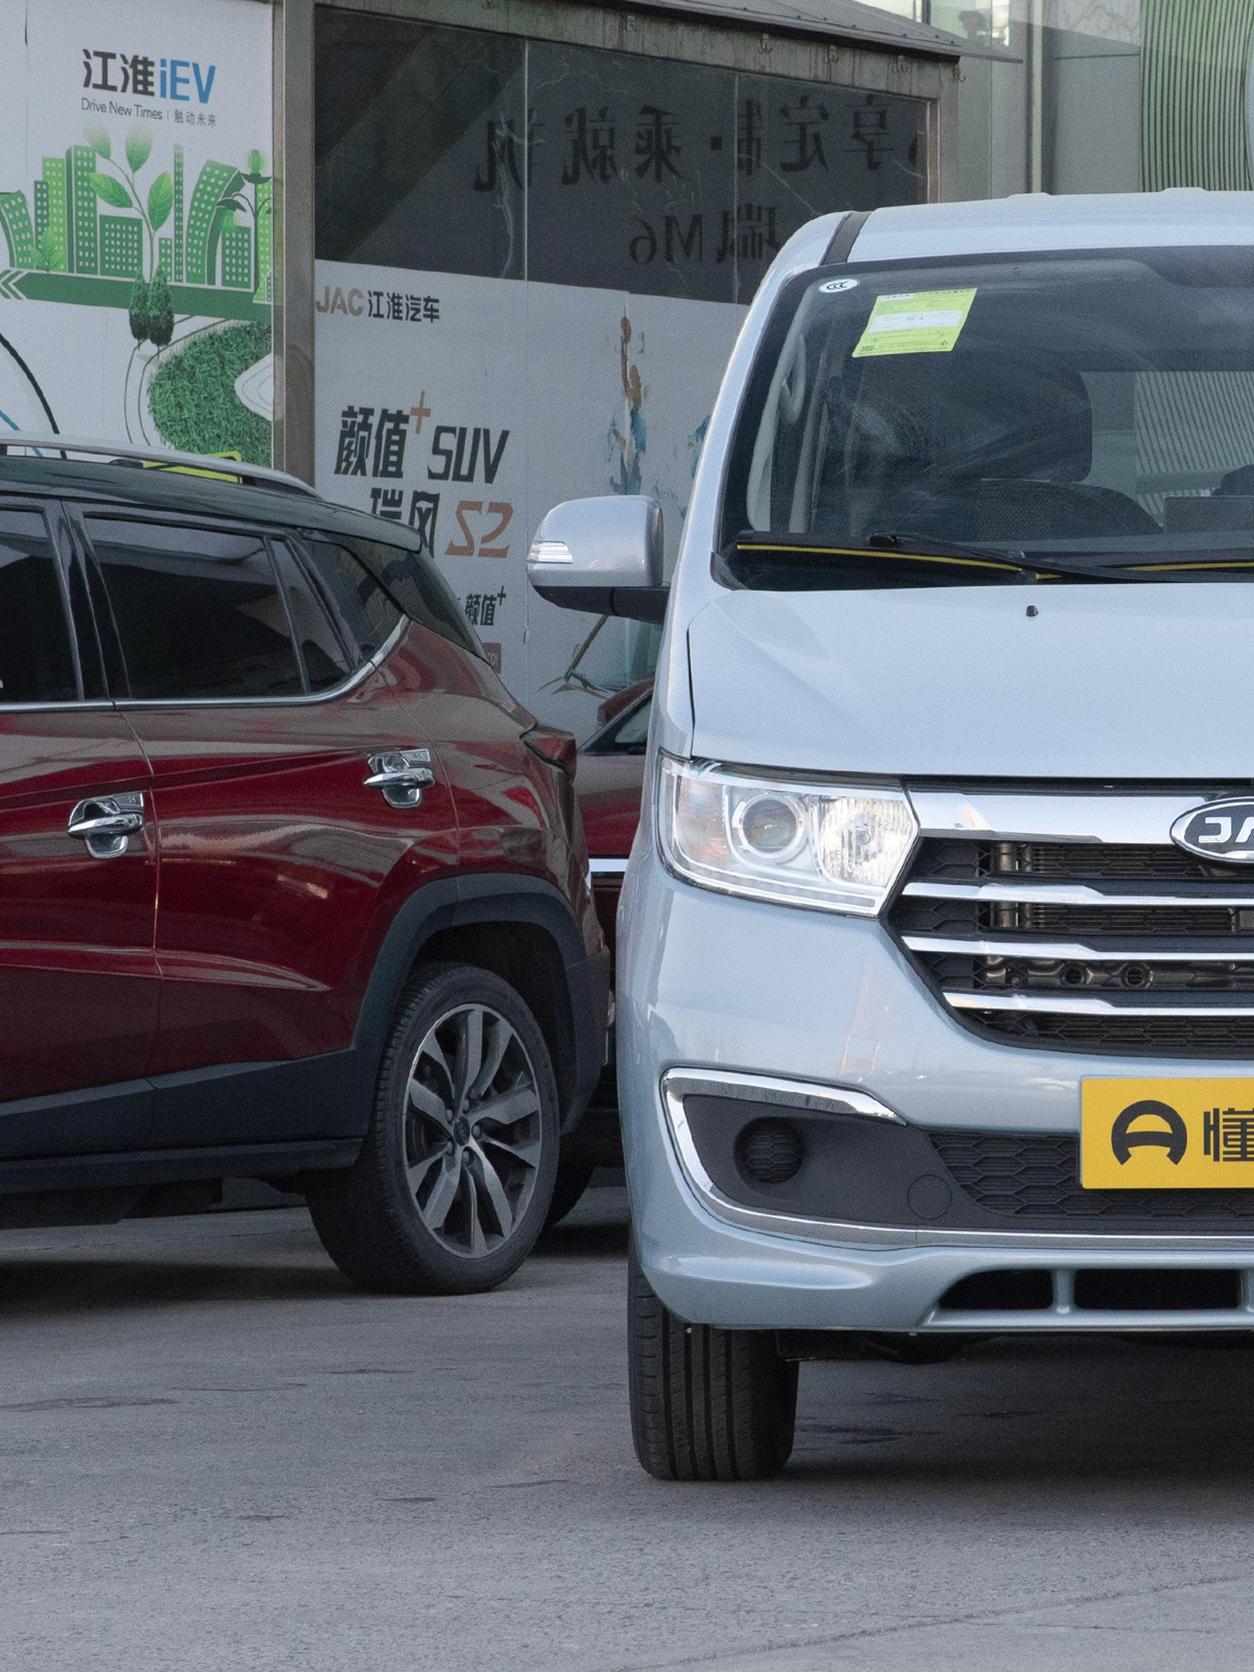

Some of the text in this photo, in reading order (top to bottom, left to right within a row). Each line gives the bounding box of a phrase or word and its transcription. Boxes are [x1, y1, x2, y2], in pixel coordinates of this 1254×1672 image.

[81, 97, 107, 113] Drive
[109, 101, 132, 117] New
[134, 104, 163, 121] Times
[315, 286, 440, 323] JAC 江淮汽车
[427, 425, 510, 484] SUV
